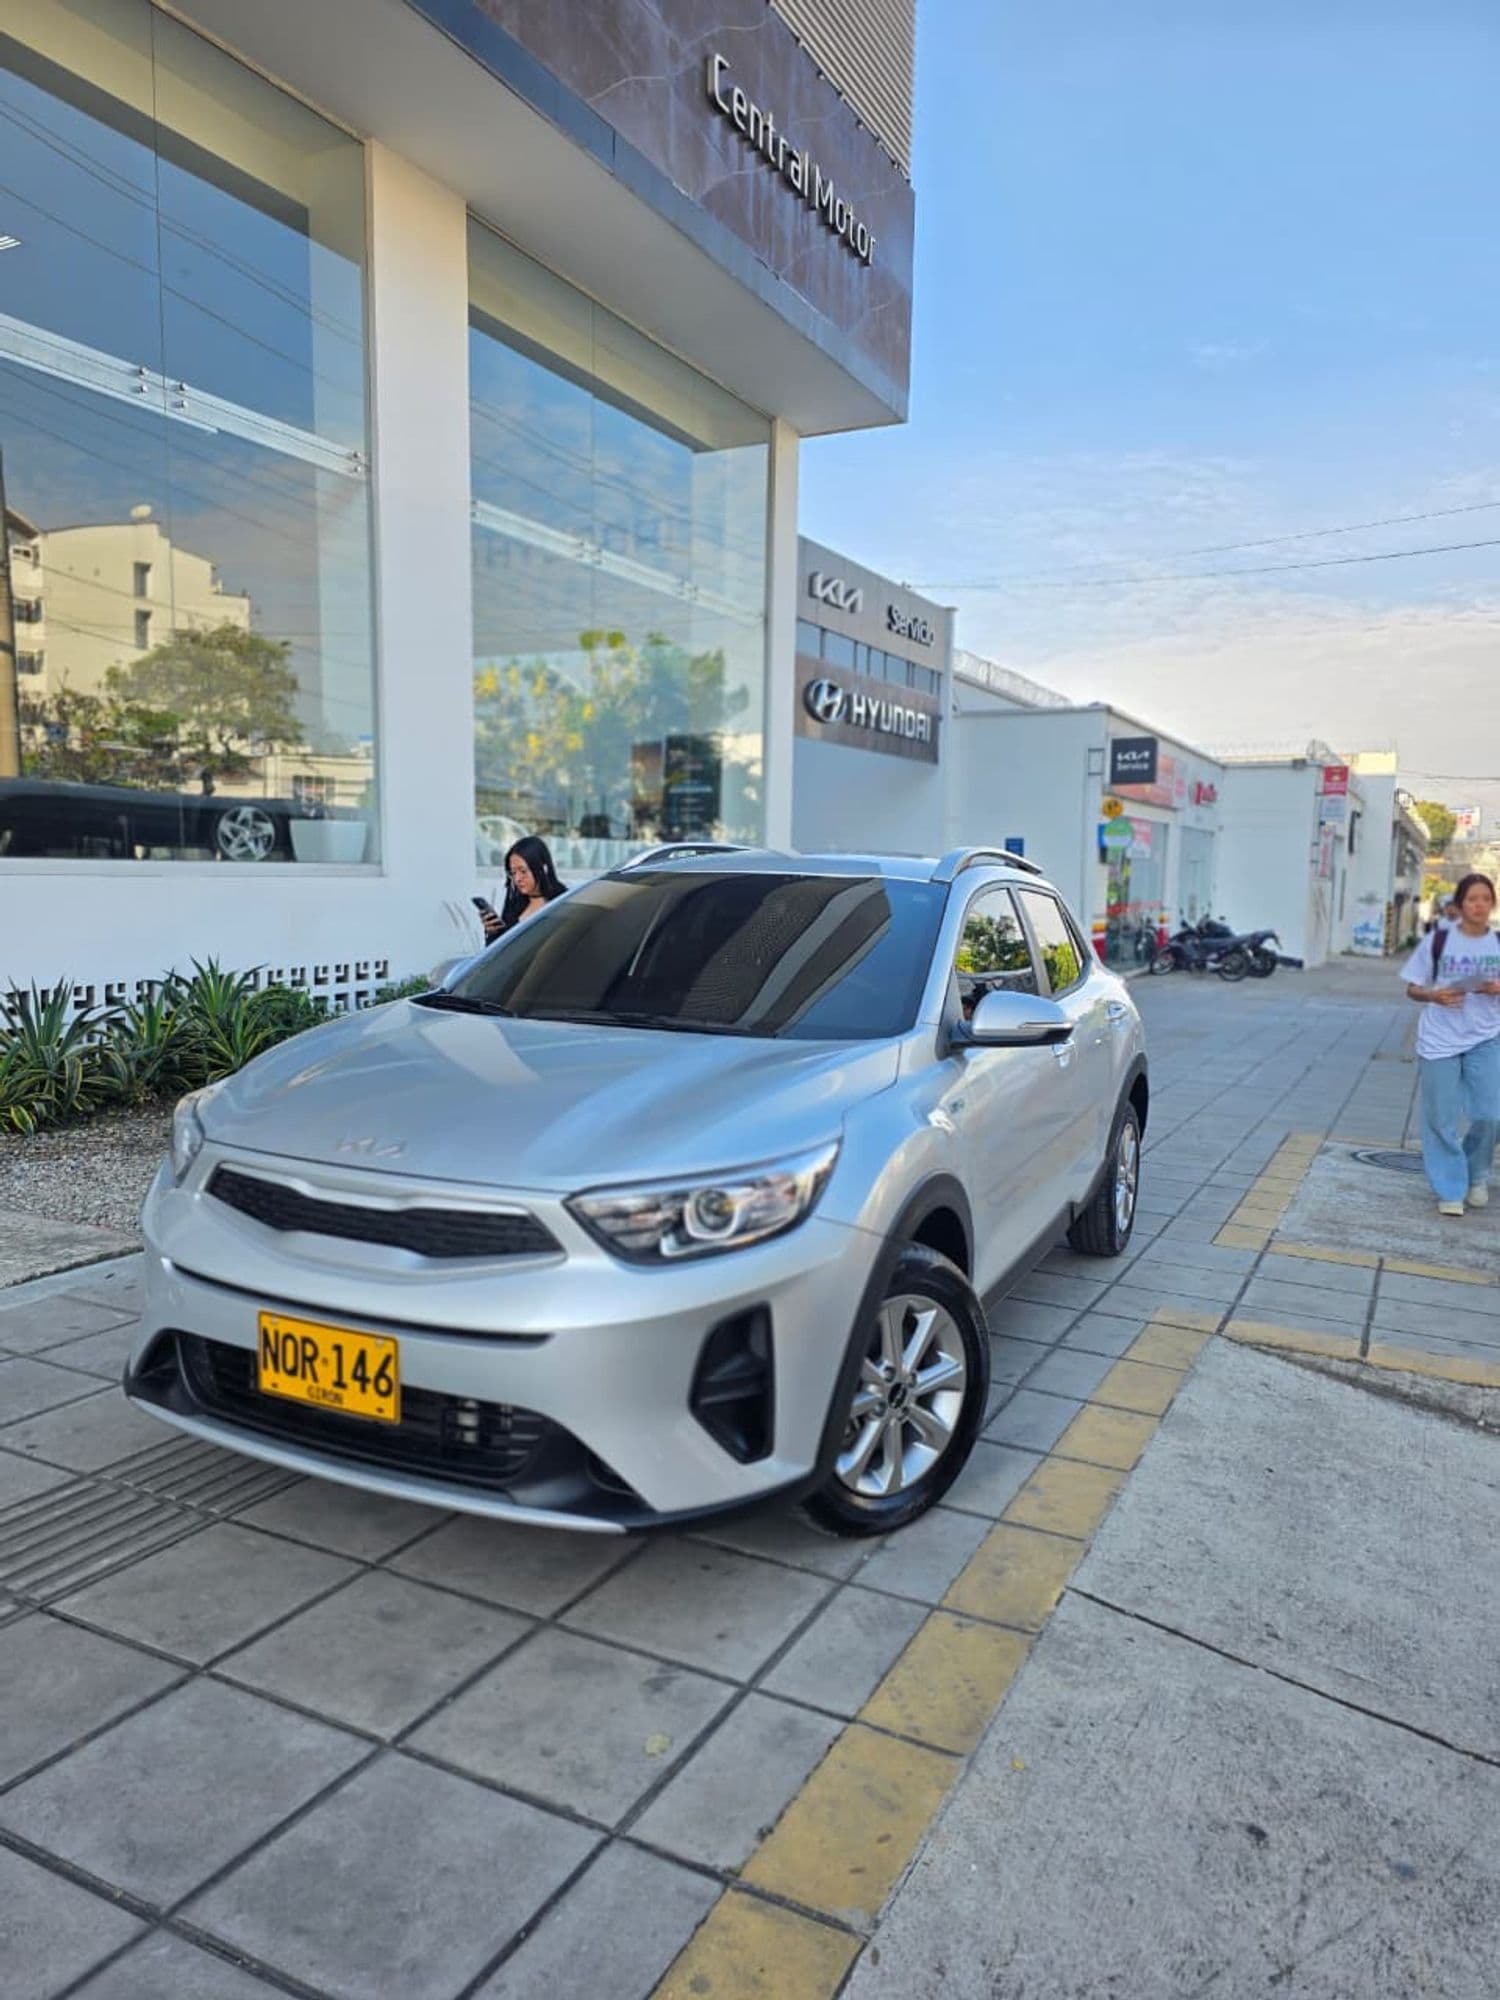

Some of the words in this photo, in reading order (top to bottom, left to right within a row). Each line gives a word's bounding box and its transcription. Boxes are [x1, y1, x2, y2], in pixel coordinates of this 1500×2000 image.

[709, 53, 810, 198] Central
[815, 163, 876, 266] Motor
[851, 691, 932, 744] HYUNDAI
